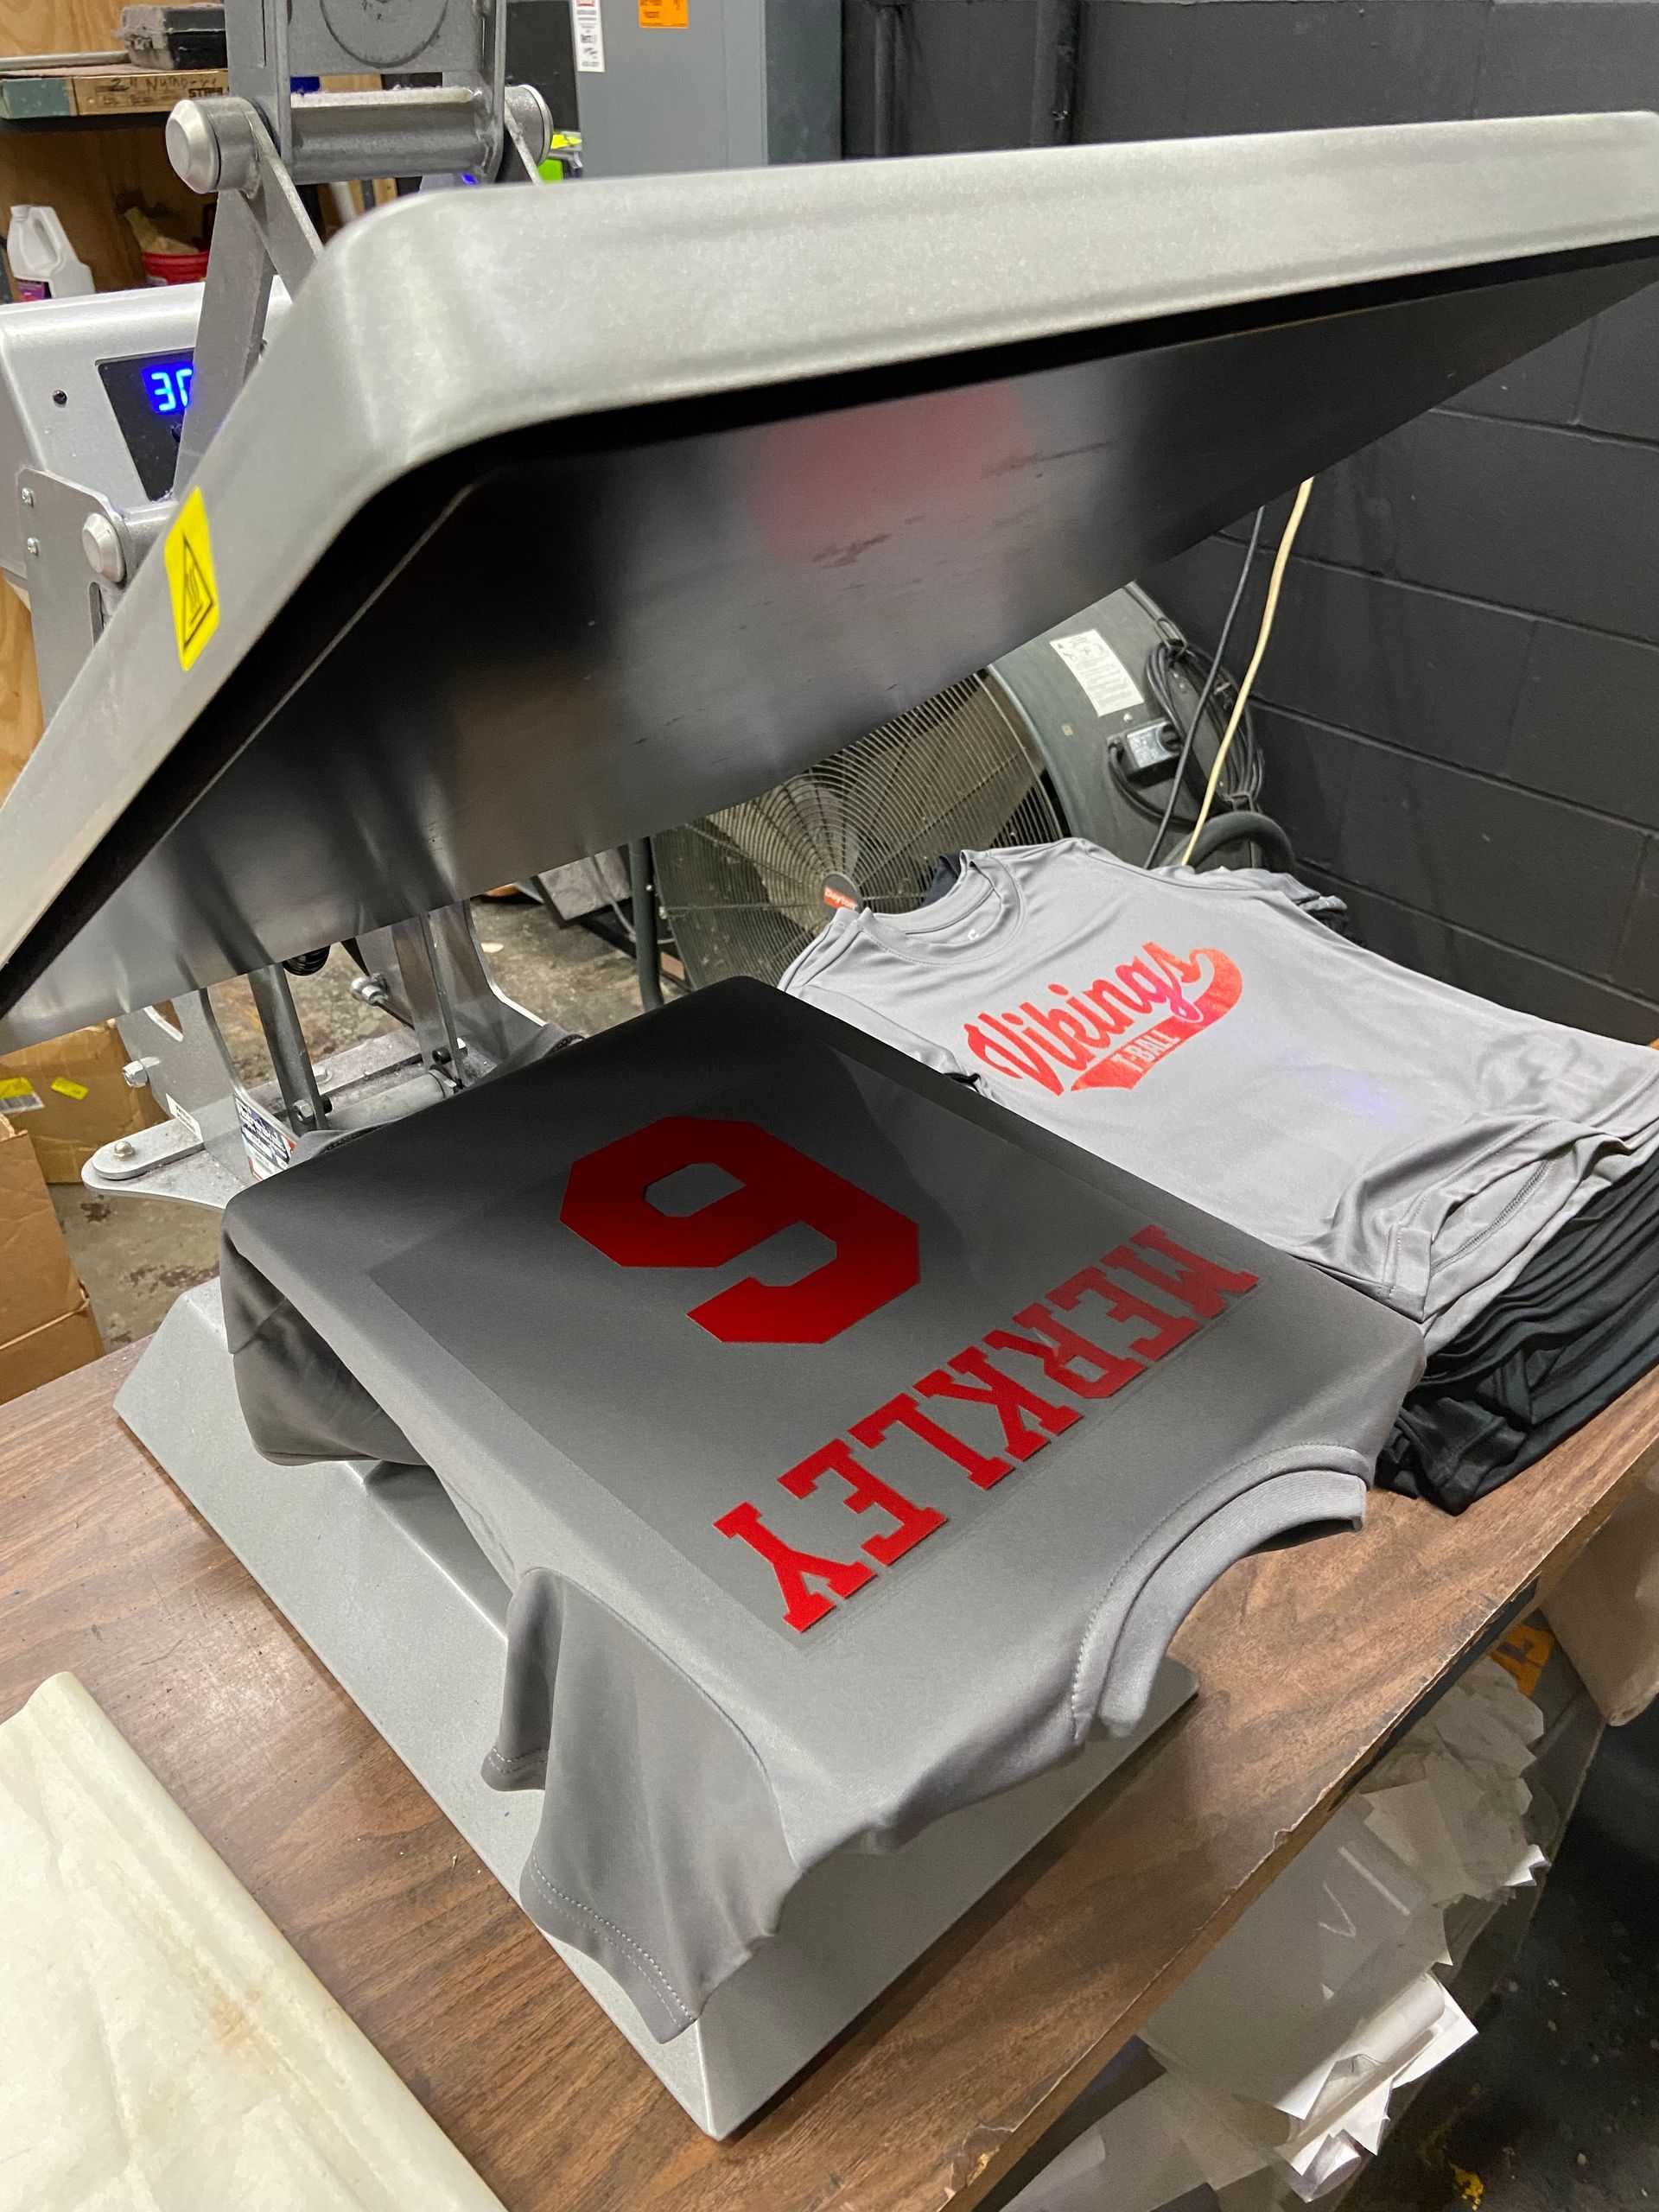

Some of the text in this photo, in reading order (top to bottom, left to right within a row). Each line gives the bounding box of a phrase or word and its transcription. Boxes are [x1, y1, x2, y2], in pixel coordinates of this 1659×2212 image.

[963, 941, 1205, 1096] Vikings
[1111, 1029, 1181, 1072] T-BALL
[559, 1116, 921, 1344] 6
[713, 1224, 1260, 1635] MERKLEY
